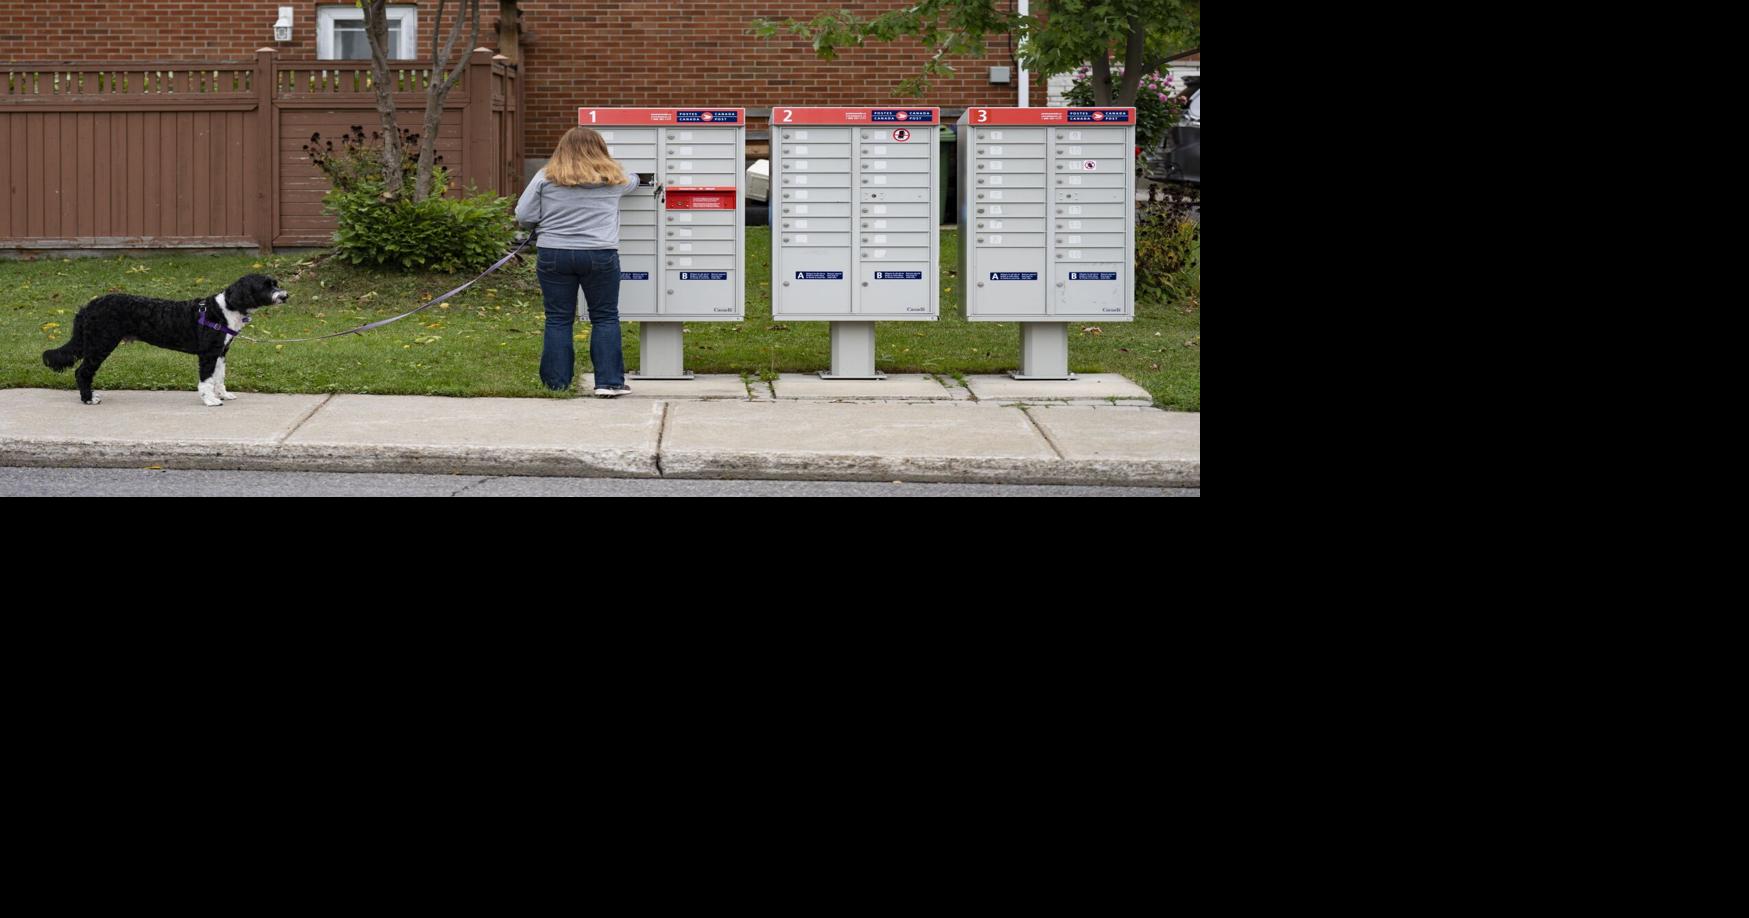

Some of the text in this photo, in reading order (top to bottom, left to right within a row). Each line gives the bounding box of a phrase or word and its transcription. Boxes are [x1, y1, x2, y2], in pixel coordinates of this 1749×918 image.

[588, 110, 597, 123] 1
[783, 110, 793, 122] 2
[977, 110, 987, 122] 3
